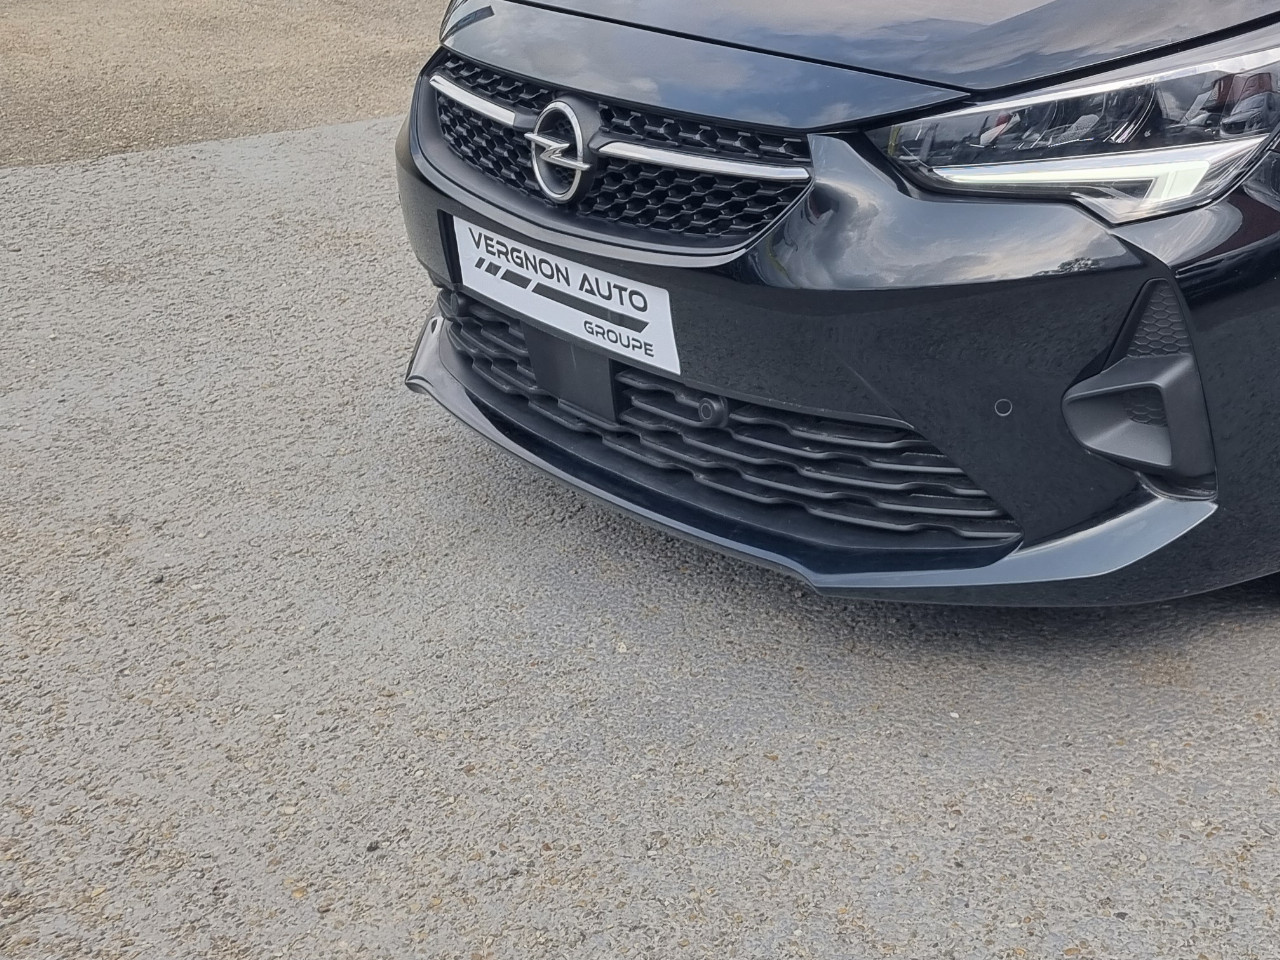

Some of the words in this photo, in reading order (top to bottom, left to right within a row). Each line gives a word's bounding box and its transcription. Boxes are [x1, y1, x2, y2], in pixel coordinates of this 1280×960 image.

[468, 226, 571, 287] VERGNON
[578, 272, 648, 313] AUTO
[583, 320, 655, 358] GROUPE
